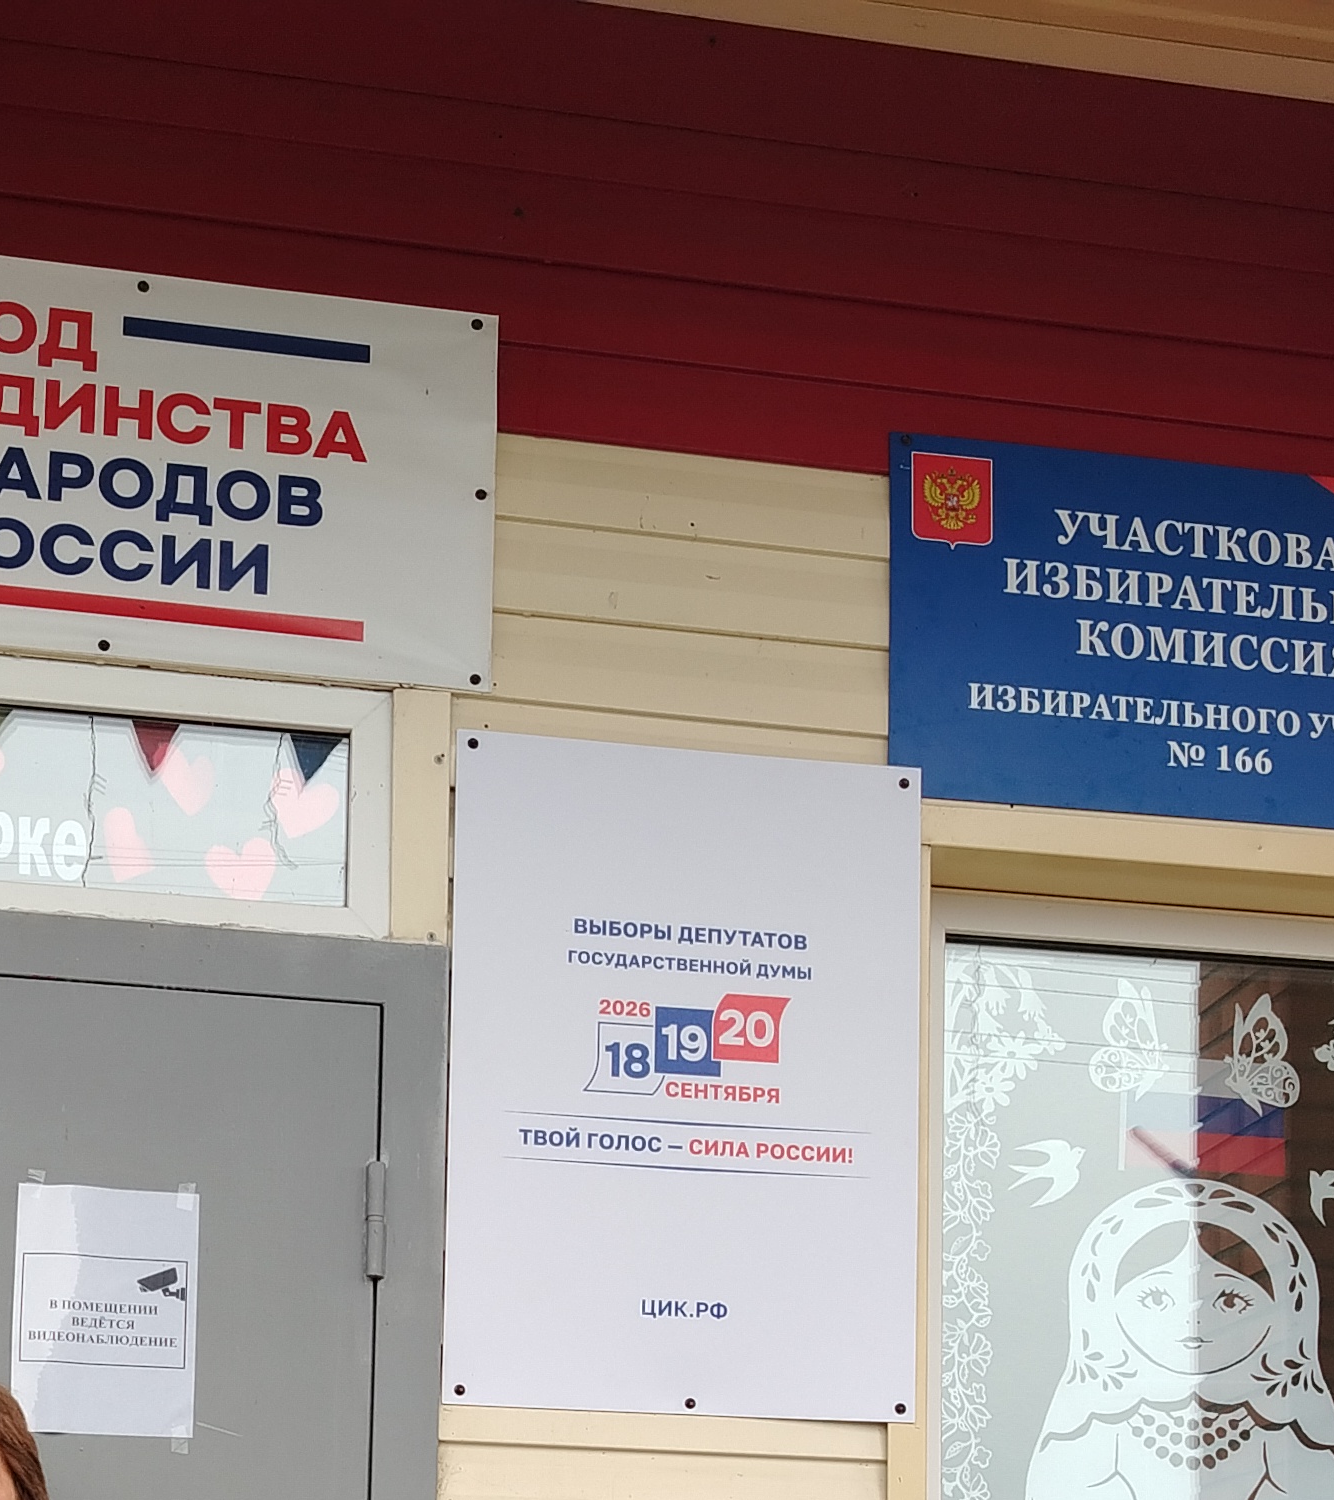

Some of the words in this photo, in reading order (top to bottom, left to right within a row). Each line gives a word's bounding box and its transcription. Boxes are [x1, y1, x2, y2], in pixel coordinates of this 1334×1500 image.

[968, 683, 1301, 737] ИЗБИРАТЕЛЬНОГО
[1167, 742, 1204, 768] №
[1216, 745, 1273, 776] 166
[573, 918, 671, 941] ВЫБОРЫ
[677, 926, 808, 950] ДЕПУТАТОВ
[568, 950, 752, 976] ГОСУДАРСТВЕННОЙ
[756, 965, 812, 981] ДУМЫ
[598, 999, 651, 1018] 2026
[605, 1042, 651, 1079] 18
[661, 1023, 708, 1062] 19
[718, 1008, 775, 1049] 20
[664, 1081, 781, 1104] СЕНТЯБРЯ
[519, 1127, 581, 1149] ТВОЙ
[587, 1131, 662, 1153] ГОЛОС
[688, 1138, 750, 1159] СИЛА
[756, 1143, 853, 1164] РОССИИ!
[49, 1299, 58, 1310] В
[62, 1299, 158, 1315] ПОМЕЩЕНИИ
[641, 1299, 728, 1320] ЦИК.РФ
[71, 1316, 135, 1330] ВЕДЁТСЯ
[28, 1330, 178, 1348] ВИДЕОНАБЛЮДЕНИЕ
